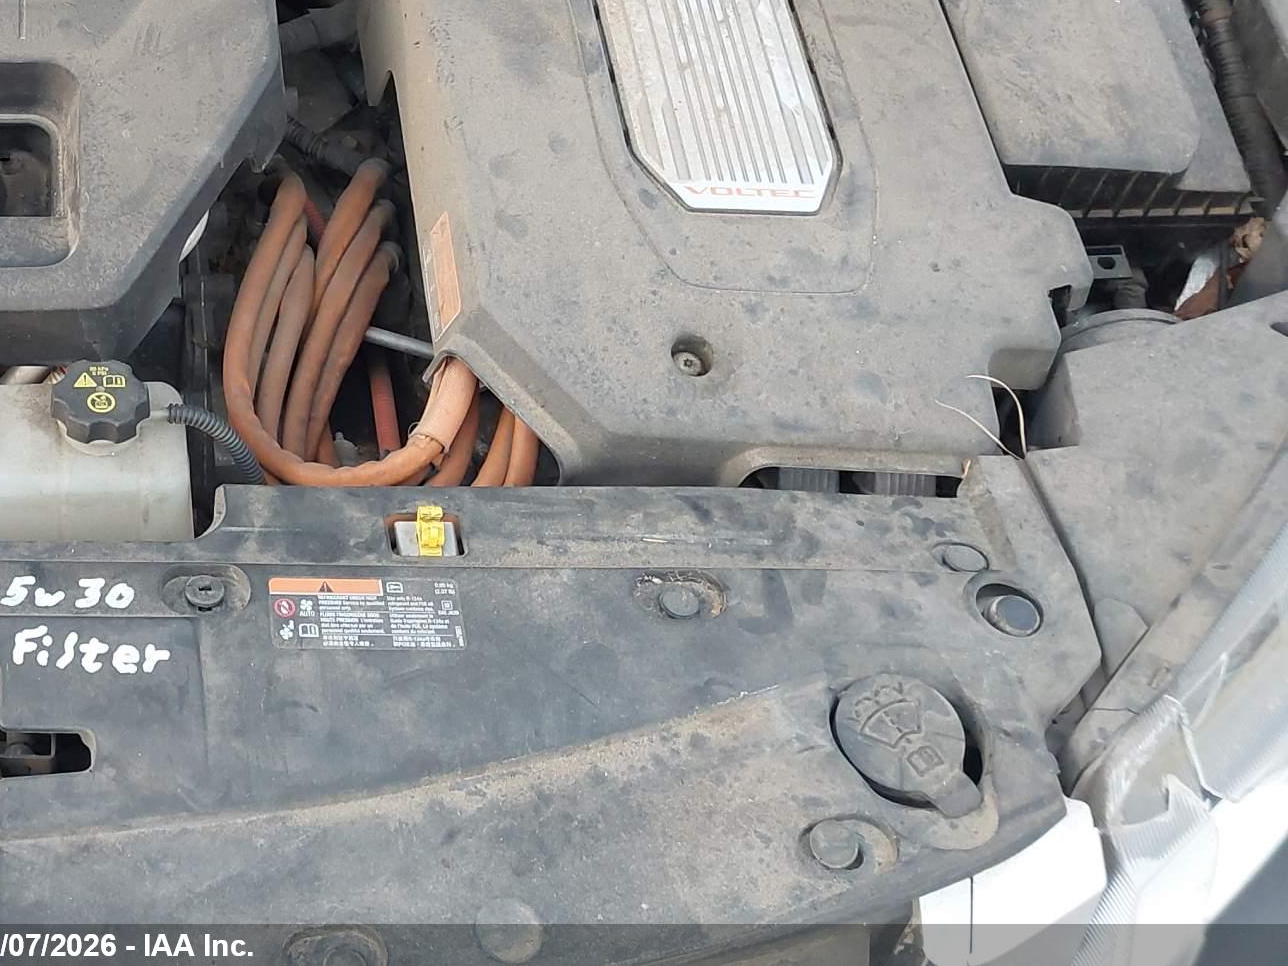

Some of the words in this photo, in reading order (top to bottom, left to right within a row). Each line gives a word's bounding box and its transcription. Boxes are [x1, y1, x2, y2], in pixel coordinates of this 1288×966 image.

[682, 185, 818, 199] VOLTEC
[74, 577, 135, 609] 30
[12, 625, 171, 674] Filter
[371, 692, 391, 701] DOT
[393, 692, 400, 701] 3
